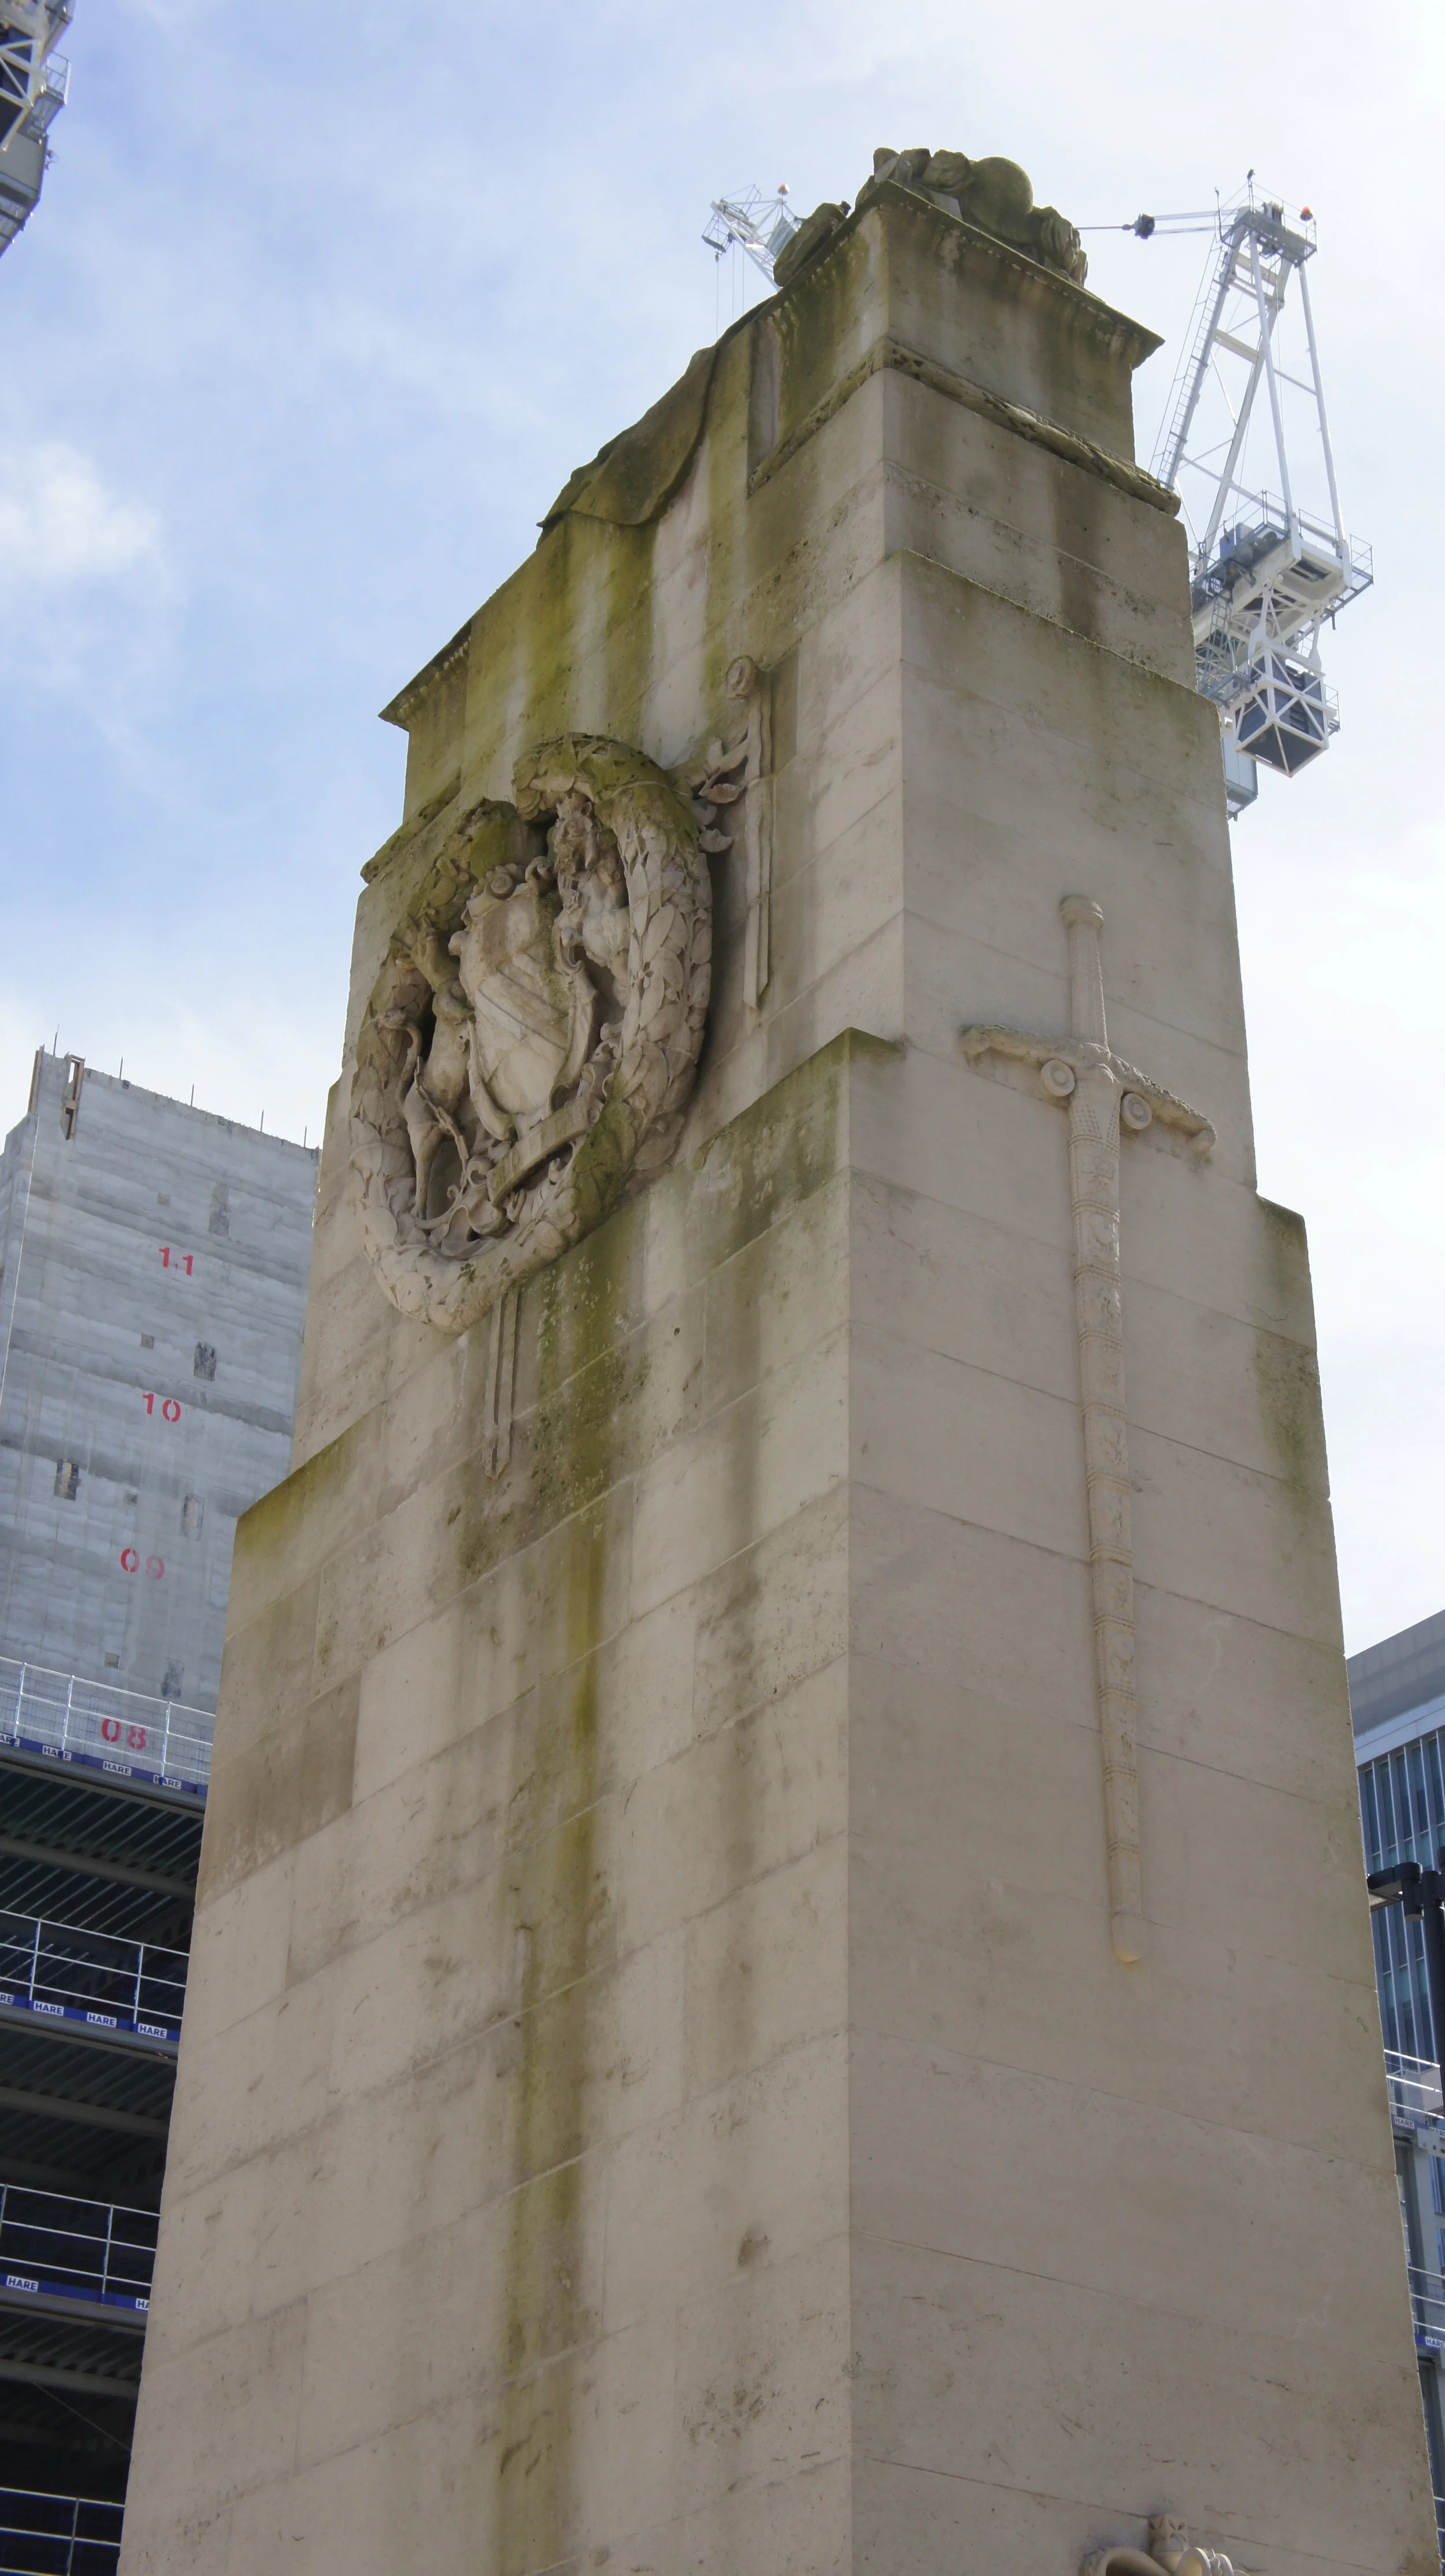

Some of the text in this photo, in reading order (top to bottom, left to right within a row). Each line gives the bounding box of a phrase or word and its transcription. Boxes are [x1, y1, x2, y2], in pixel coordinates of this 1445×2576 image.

[159, 1247, 193, 1276] 11
[143, 1392, 181, 1422] 10
[121, 1548, 165, 1580] 09
[0, 1734, 19, 1745] ARE
[101, 1718, 146, 1750] 08
[43, 1747, 71, 1759] HAE
[104, 1762, 131, 1775] HARE
[0, 1994, 13, 2003] RE
[35, 2002, 62, 2015] HARE
[88, 2014, 116, 2026] HARE
[140, 2025, 166, 2037] HARE
[1395, 2117, 1414, 2128] HARE
[8, 2277, 36, 2291] HARE
[138, 2300, 149, 2309] HA
